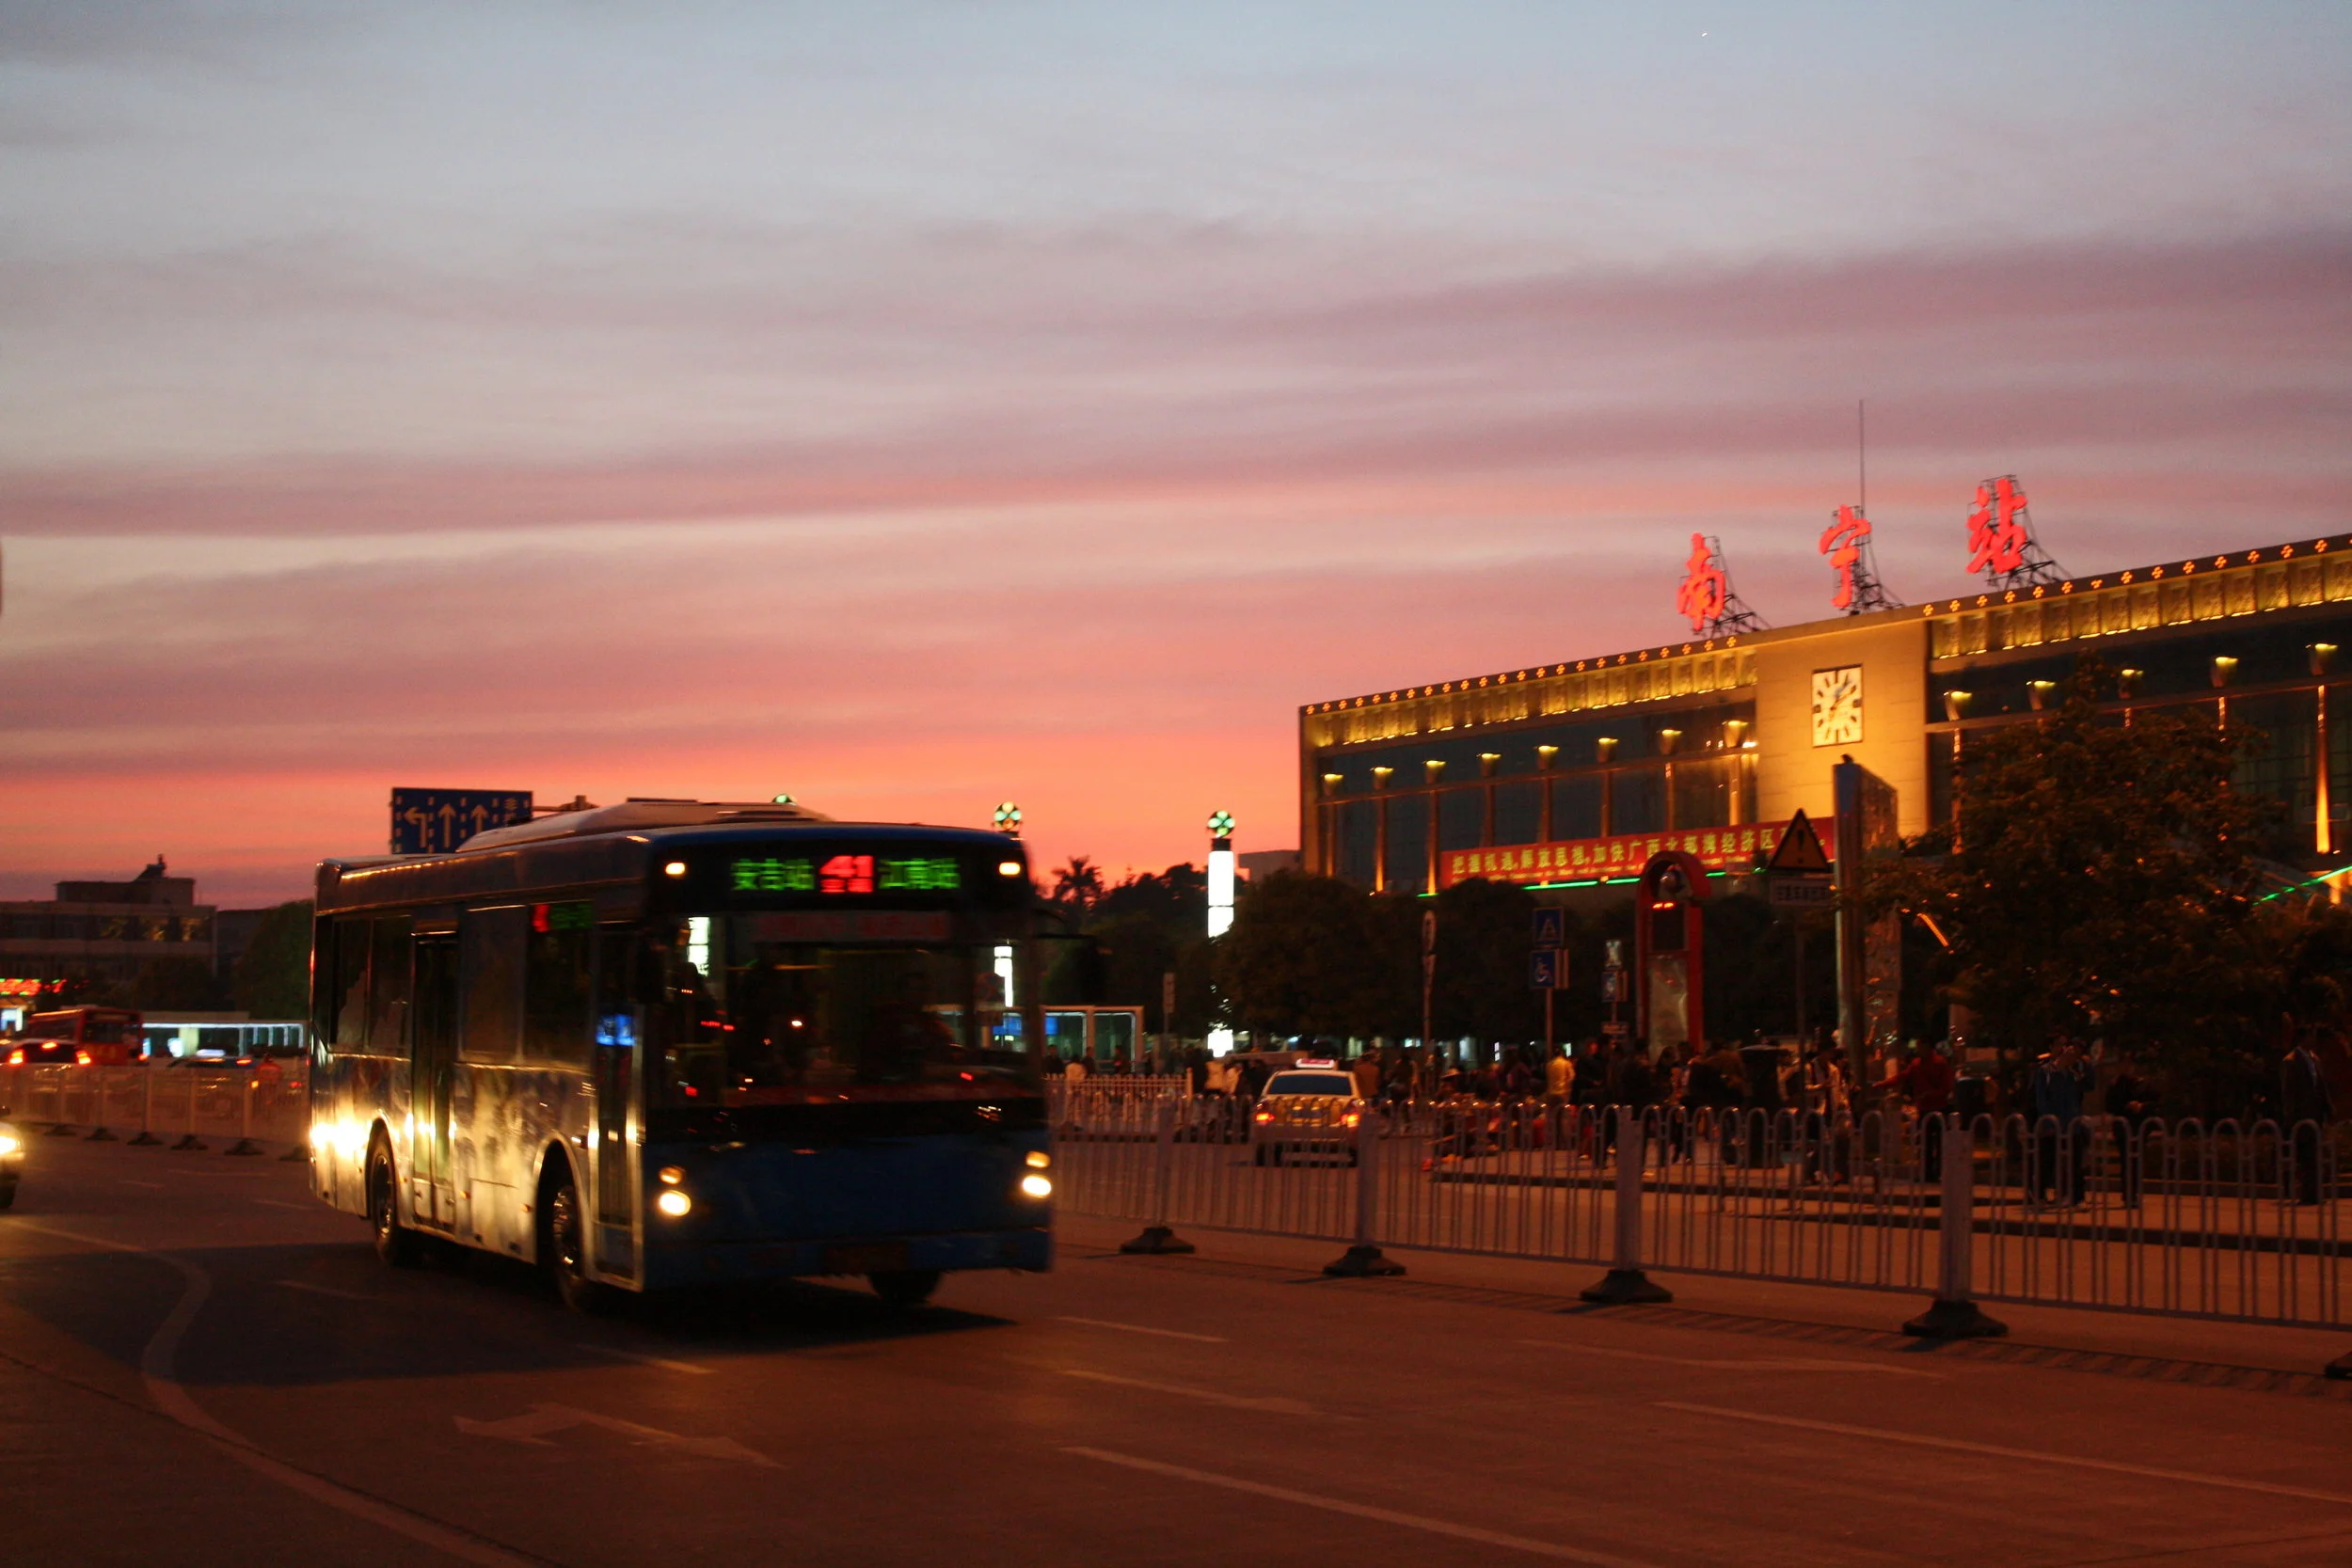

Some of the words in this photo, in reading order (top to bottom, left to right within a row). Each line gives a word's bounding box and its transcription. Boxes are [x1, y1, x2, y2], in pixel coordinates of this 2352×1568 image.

[1677, 478, 2027, 632] 南宁站
[819, 855, 874, 879] 41
